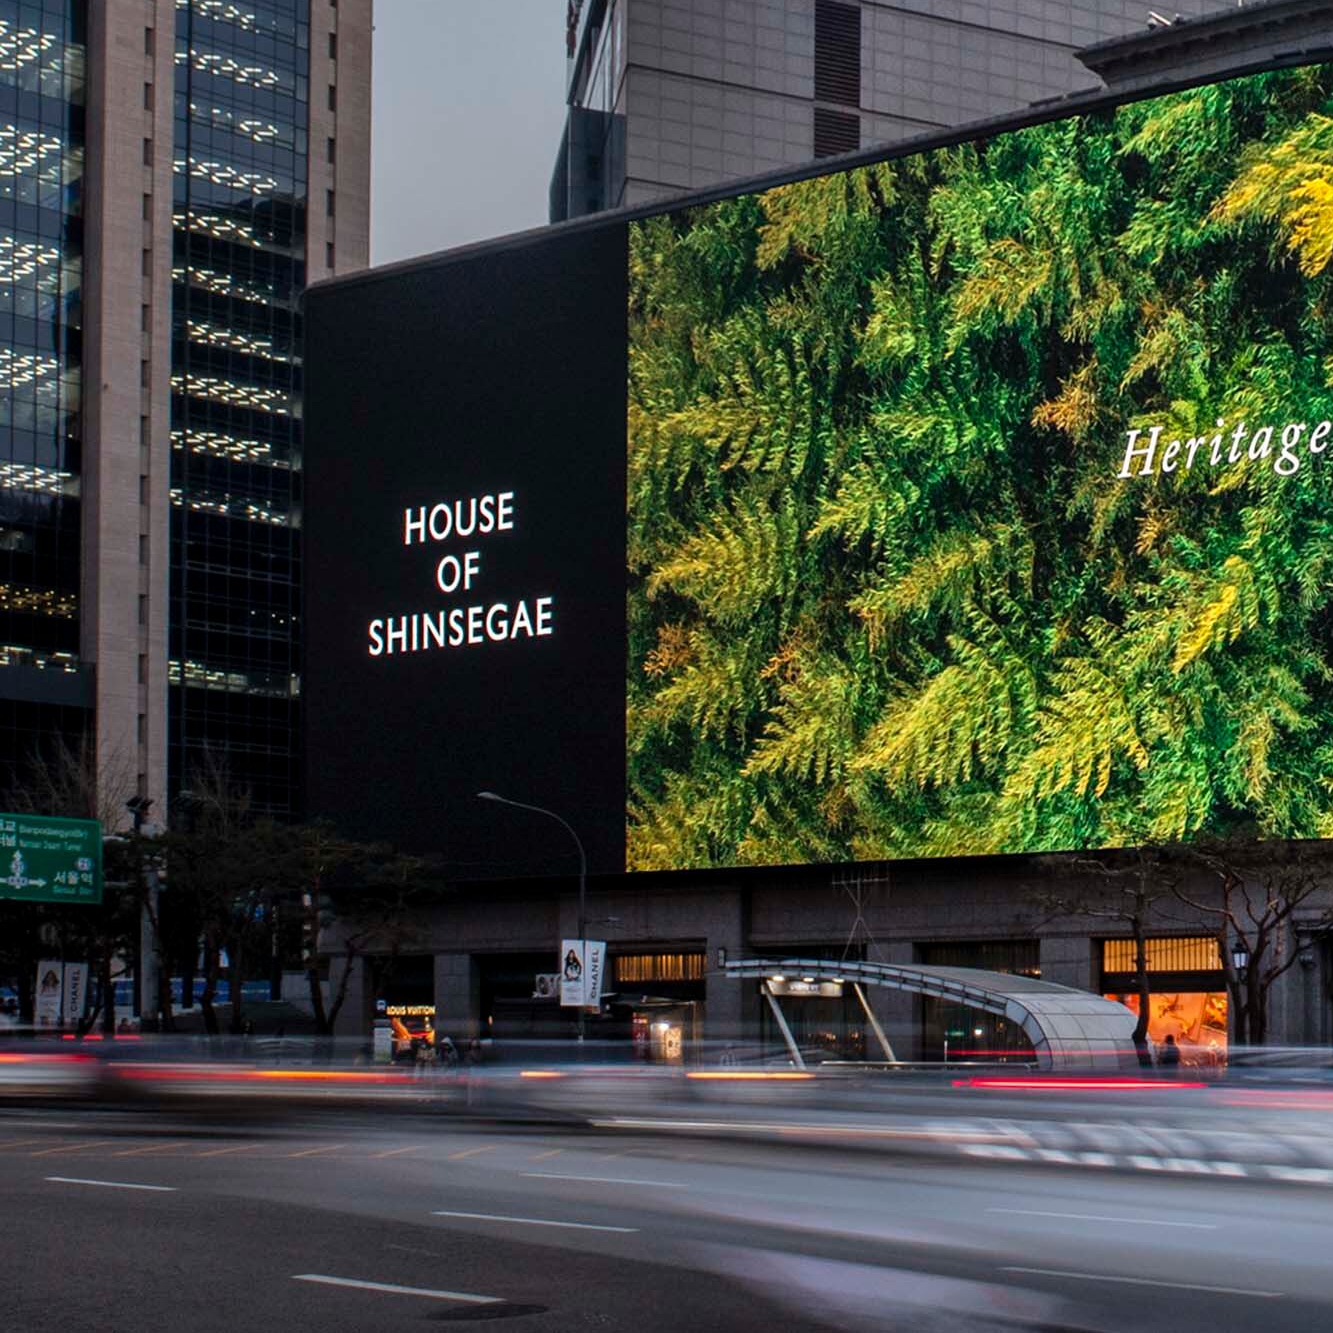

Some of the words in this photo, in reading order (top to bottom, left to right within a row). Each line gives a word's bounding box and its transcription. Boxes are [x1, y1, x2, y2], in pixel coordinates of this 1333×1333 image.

[1117, 417, 1332, 479] Heritage
[404, 491, 514, 545] HOUSE
[437, 551, 480, 593] OF
[368, 597, 553, 656] SHINSEGAE
[53, 870, 94, 886] 서울역
[71, 969, 81, 1012] CHANEL
[590, 948, 600, 998] CHANEL
[407, 1005, 436, 1015] VUITTON
